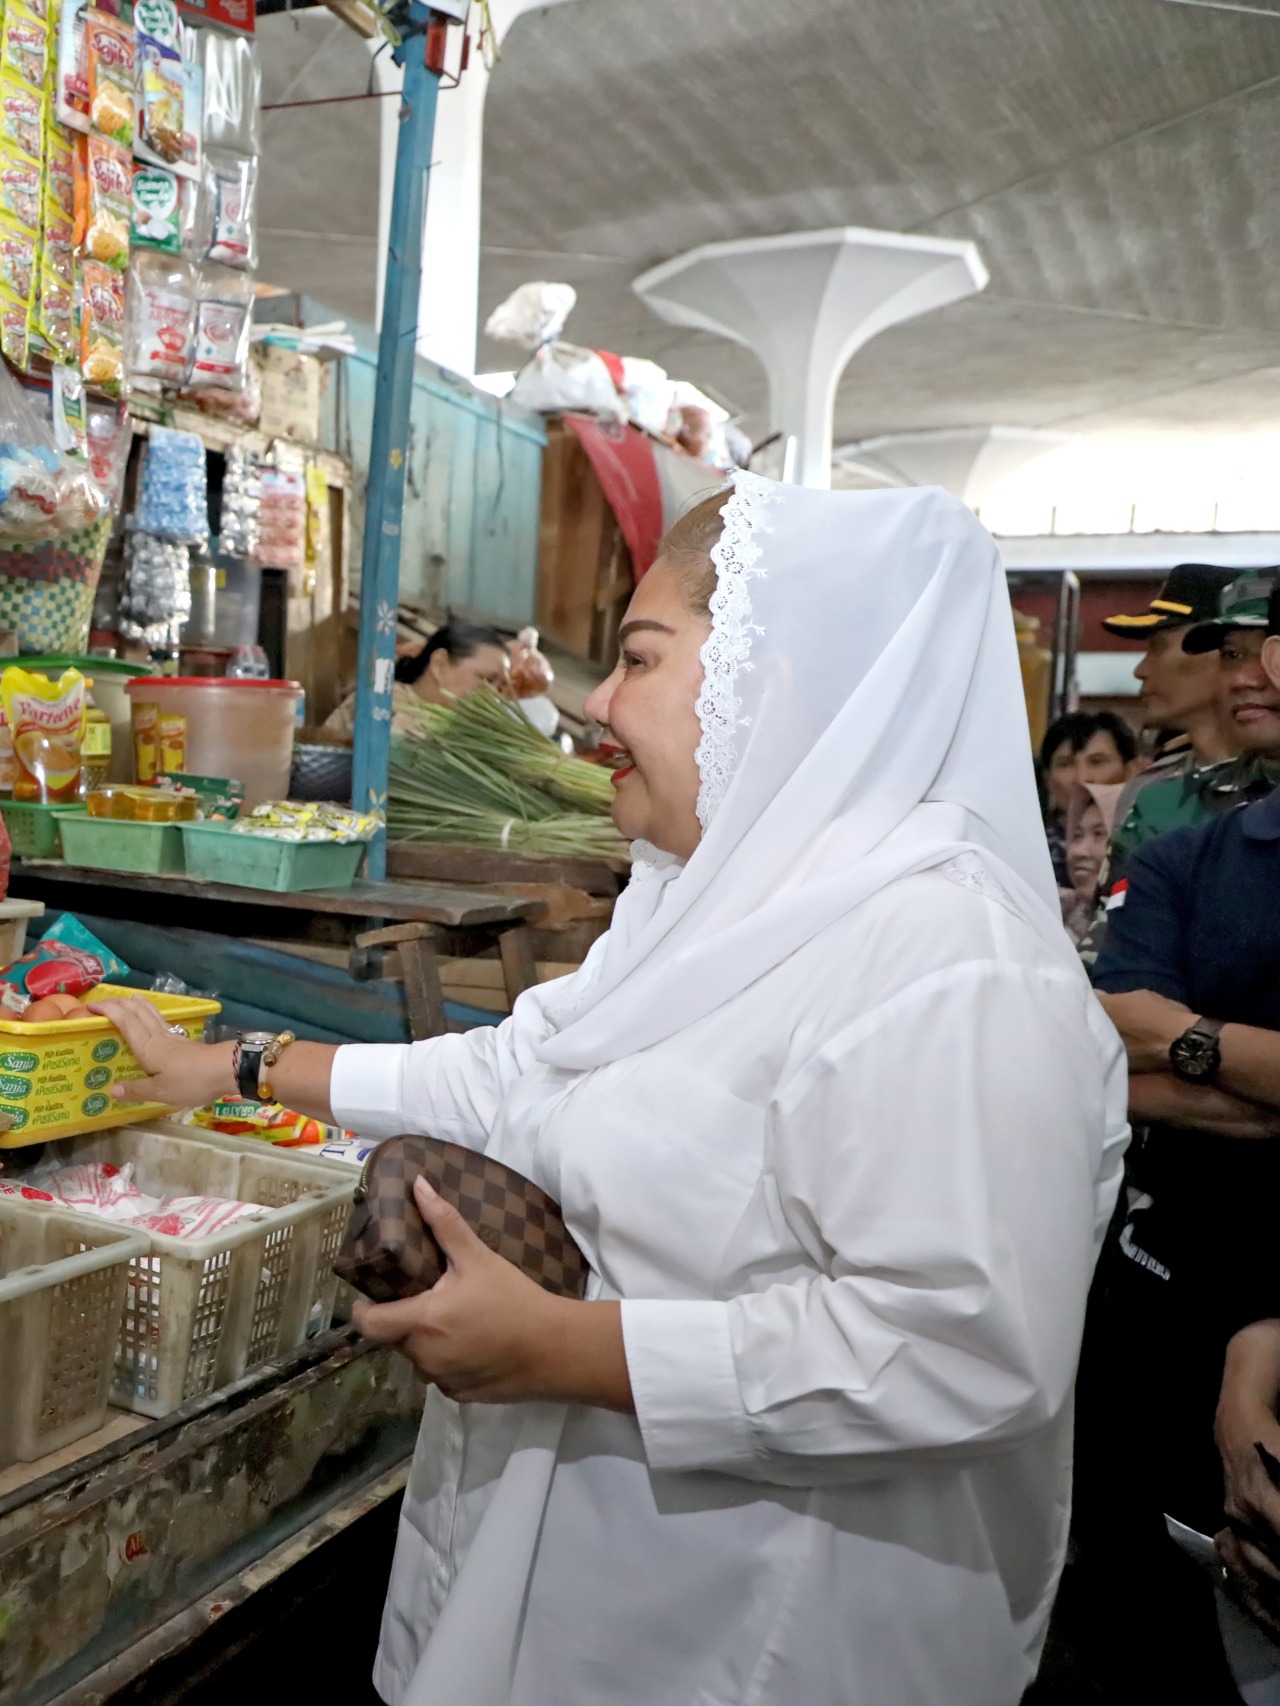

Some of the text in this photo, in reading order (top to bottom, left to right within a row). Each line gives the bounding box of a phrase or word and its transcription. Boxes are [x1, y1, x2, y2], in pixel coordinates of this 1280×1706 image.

[5, 1055, 34, 1071] Sania
[42, 1056, 80, 1071] #PastiSania
[35, 1081, 73, 1096] #PastiSania
[32, 1110, 71, 1125] #PastiSania
